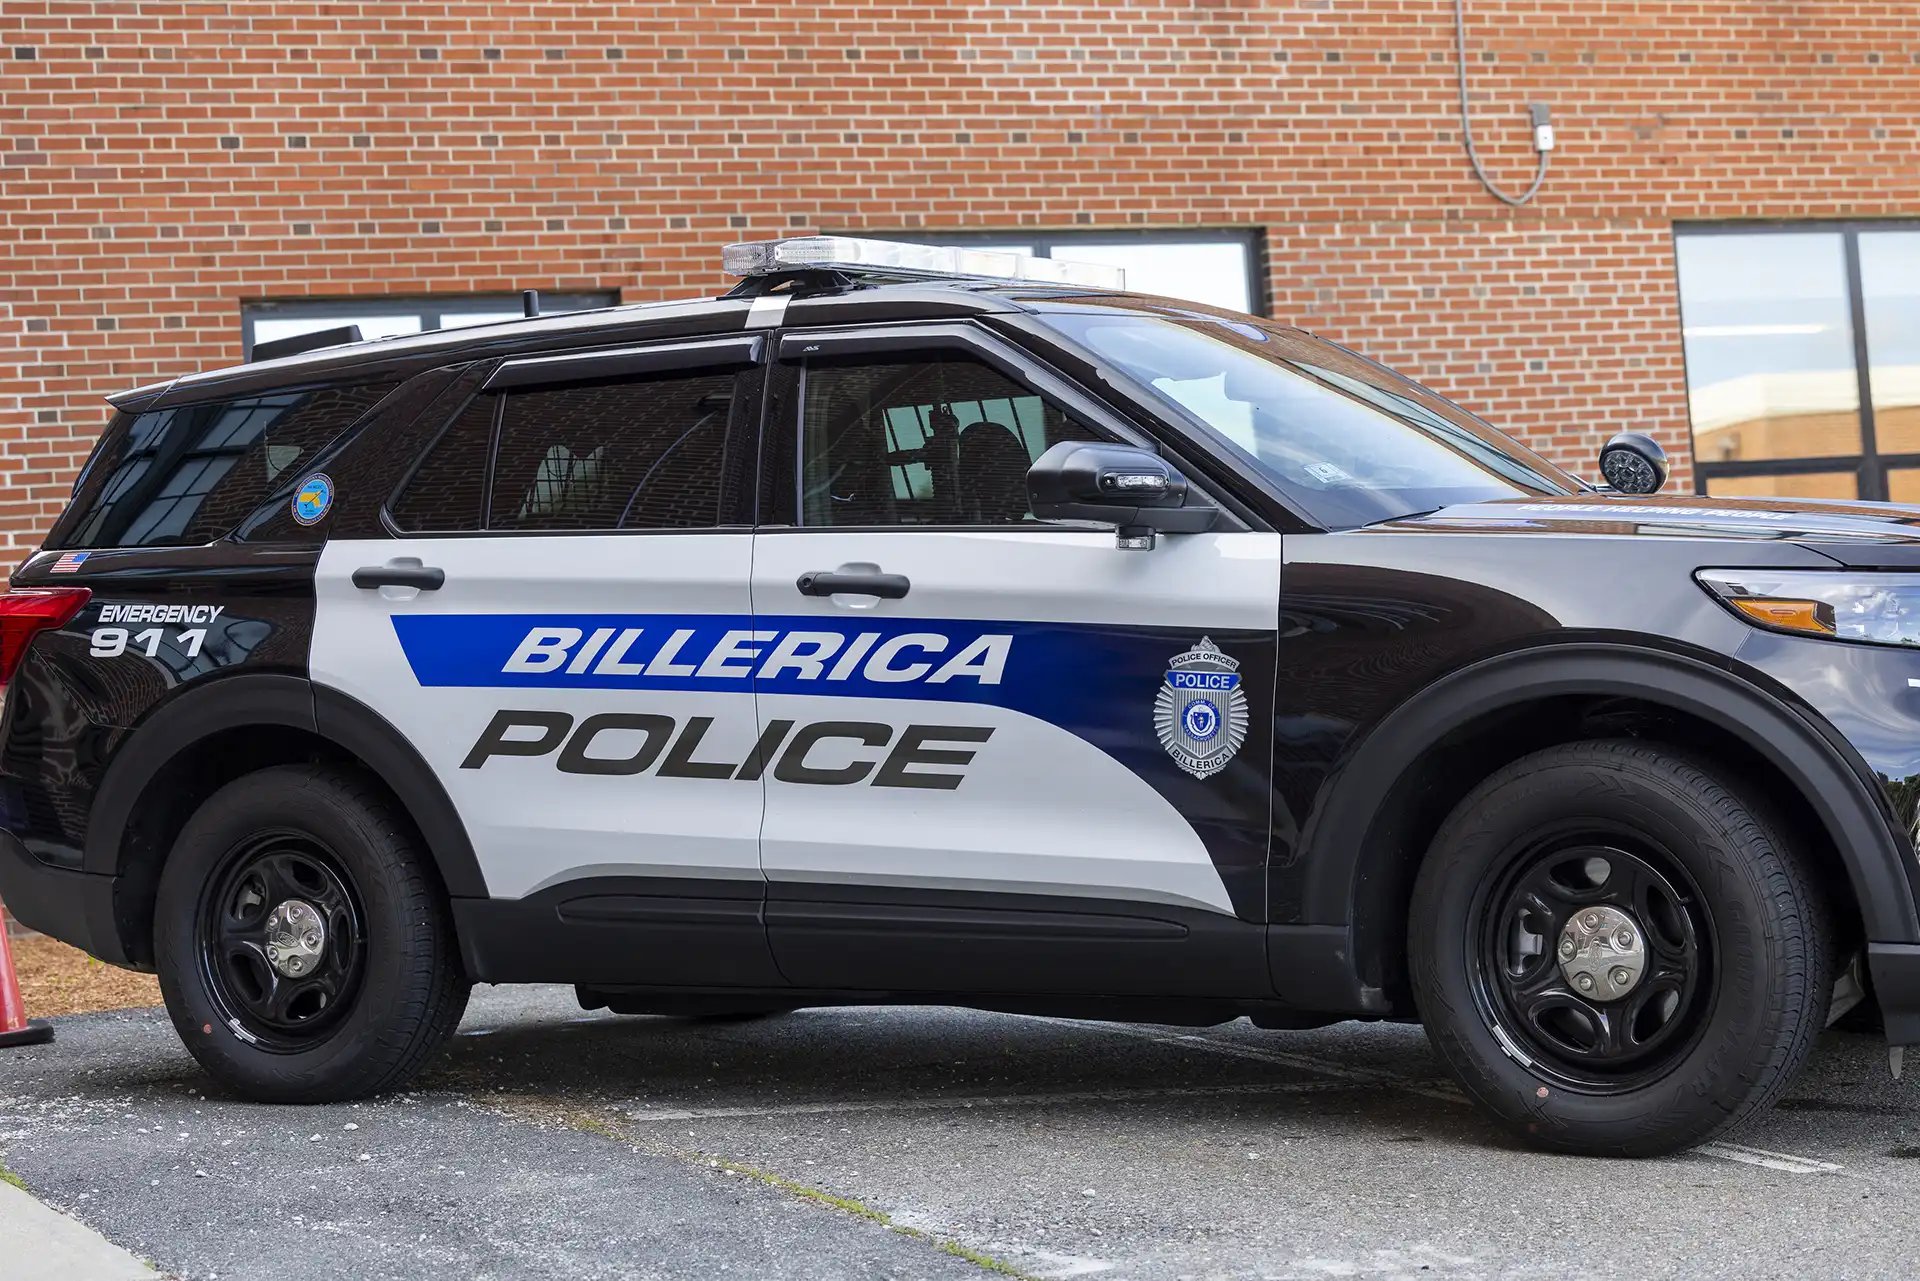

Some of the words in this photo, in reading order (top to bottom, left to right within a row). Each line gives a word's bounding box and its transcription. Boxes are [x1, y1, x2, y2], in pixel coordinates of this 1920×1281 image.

[1517, 504, 1600, 512] PEOPLE
[1602, 506, 1700, 515] HELPING
[1702, 509, 1791, 520] PEOPLE
[98, 605, 225, 624] EMERGENCY
[90, 627, 207, 658] 911
[501, 627, 1014, 685] BILLERICA
[1171, 653, 1201, 666] POLICE
[1203, 653, 1237, 669] OFFICER
[1175, 673, 1230, 689] POLICE
[459, 709, 996, 790] POLICE
[1171, 749, 1229, 769] BILLERICA
